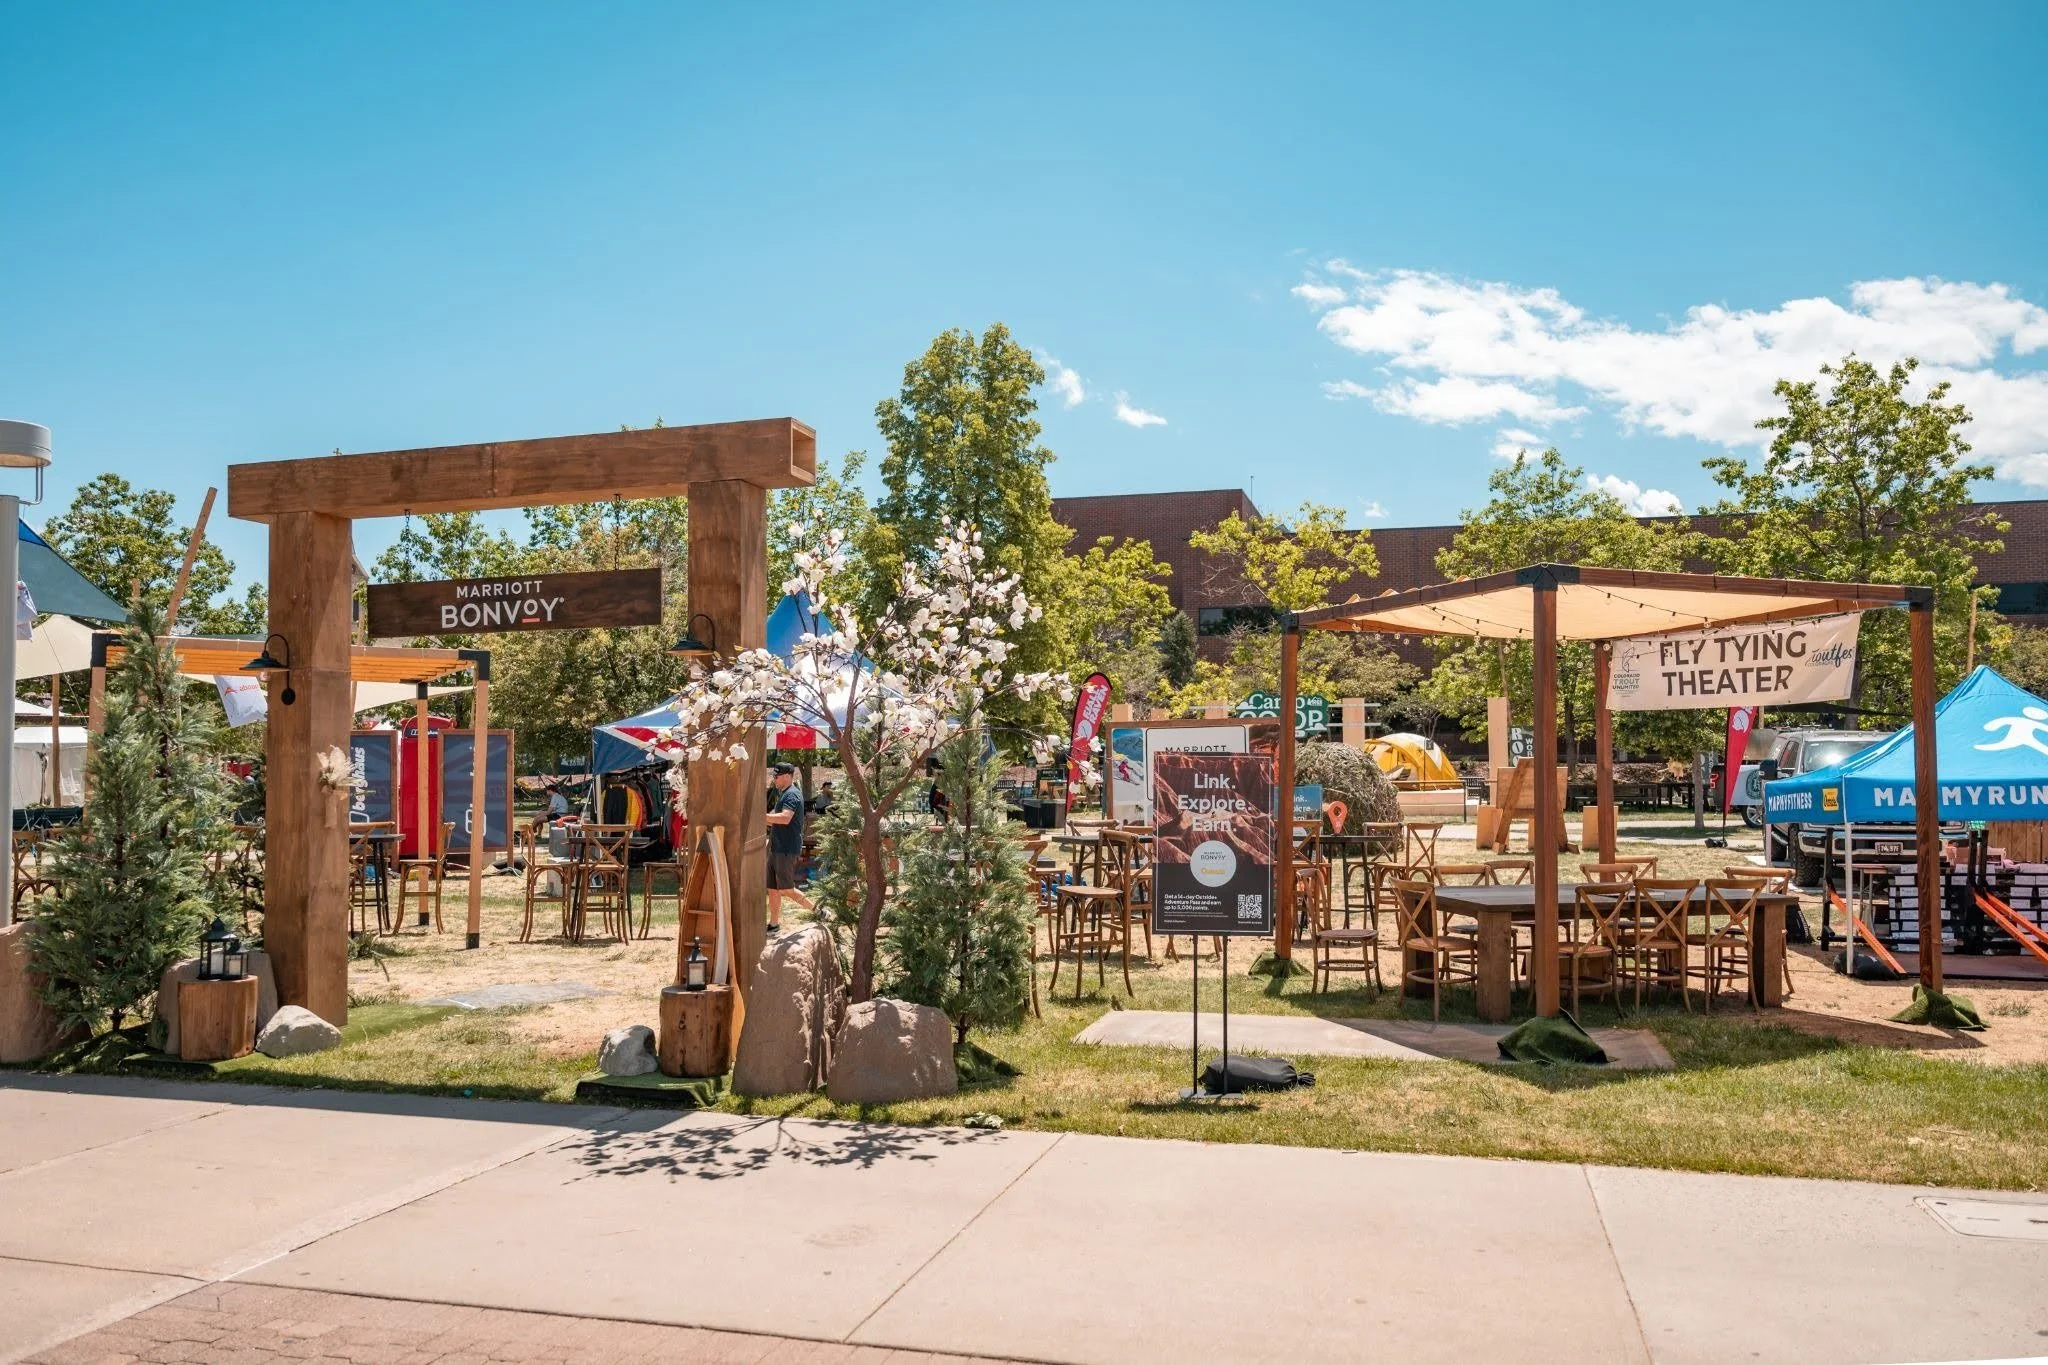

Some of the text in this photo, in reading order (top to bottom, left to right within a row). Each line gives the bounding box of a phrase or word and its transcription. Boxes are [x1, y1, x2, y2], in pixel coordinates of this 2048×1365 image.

[456, 580, 543, 599] MARRIOTT
[441, 597, 561, 629] BONVOY
[1659, 630, 1807, 667] FLY TYING
[1661, 665, 1794, 697] THEATER
[1194, 773, 1236, 789] Link.
[1177, 795, 1252, 814] Explore.
[1768, 791, 1813, 812] MAPMYFITNESS
[1873, 785, 2048, 807] MAMYRUN
[1192, 816, 1237, 832] Earn.
